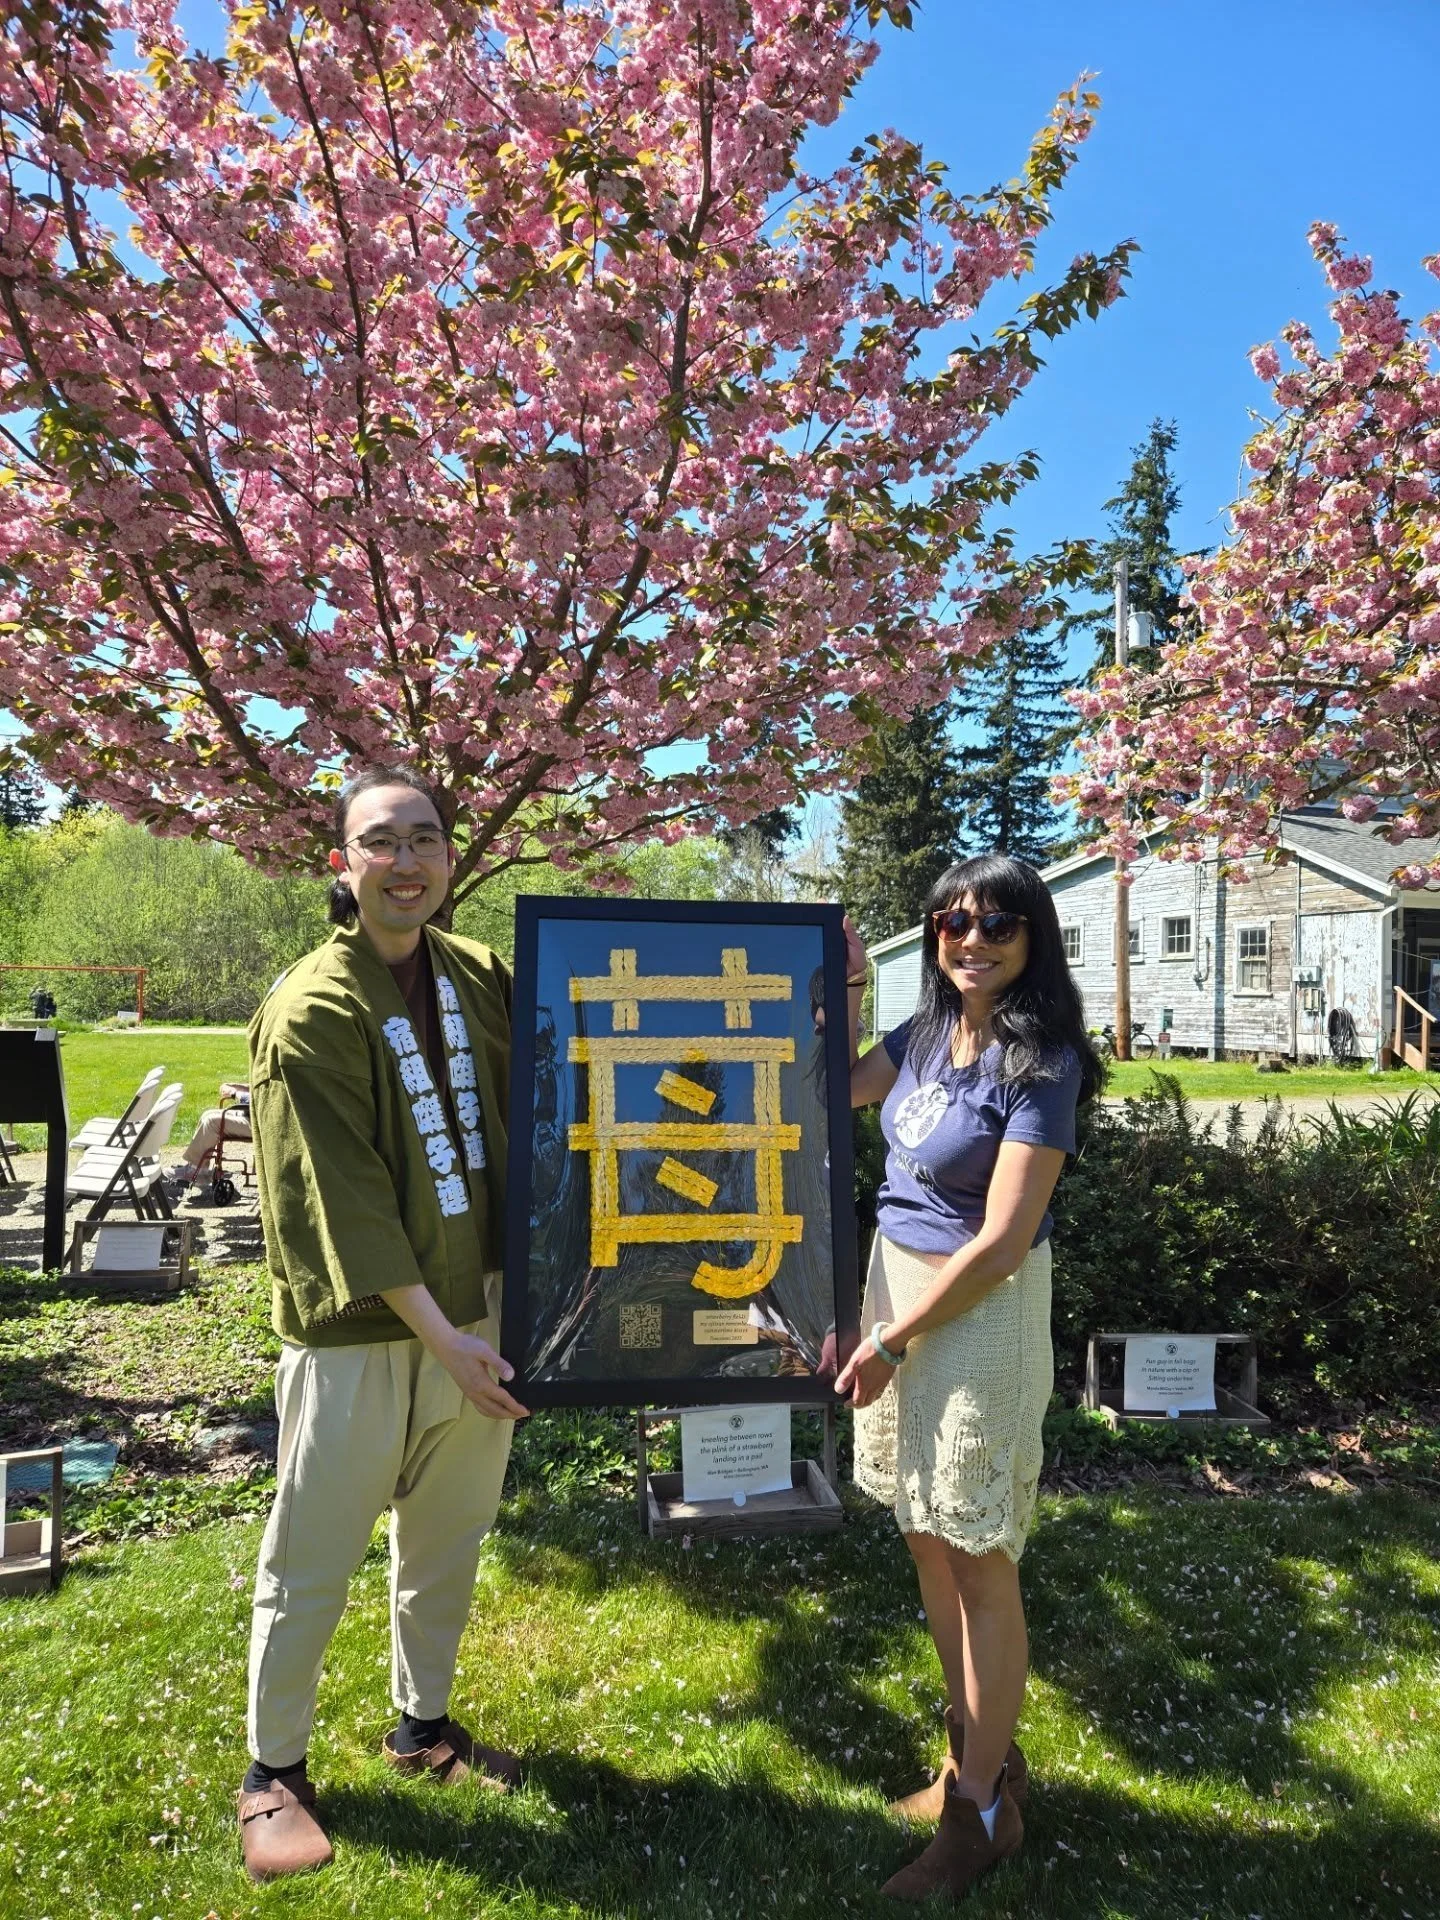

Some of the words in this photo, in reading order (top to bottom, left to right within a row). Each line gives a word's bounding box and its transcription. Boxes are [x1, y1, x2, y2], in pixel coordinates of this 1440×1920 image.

[702, 1435, 728, 1443] kneeling
[712, 1445, 727, 1454] plink
[742, 1442, 774, 1450] strawberry
[713, 1455, 736, 1463] landing
[751, 1452, 763, 1461] pail
